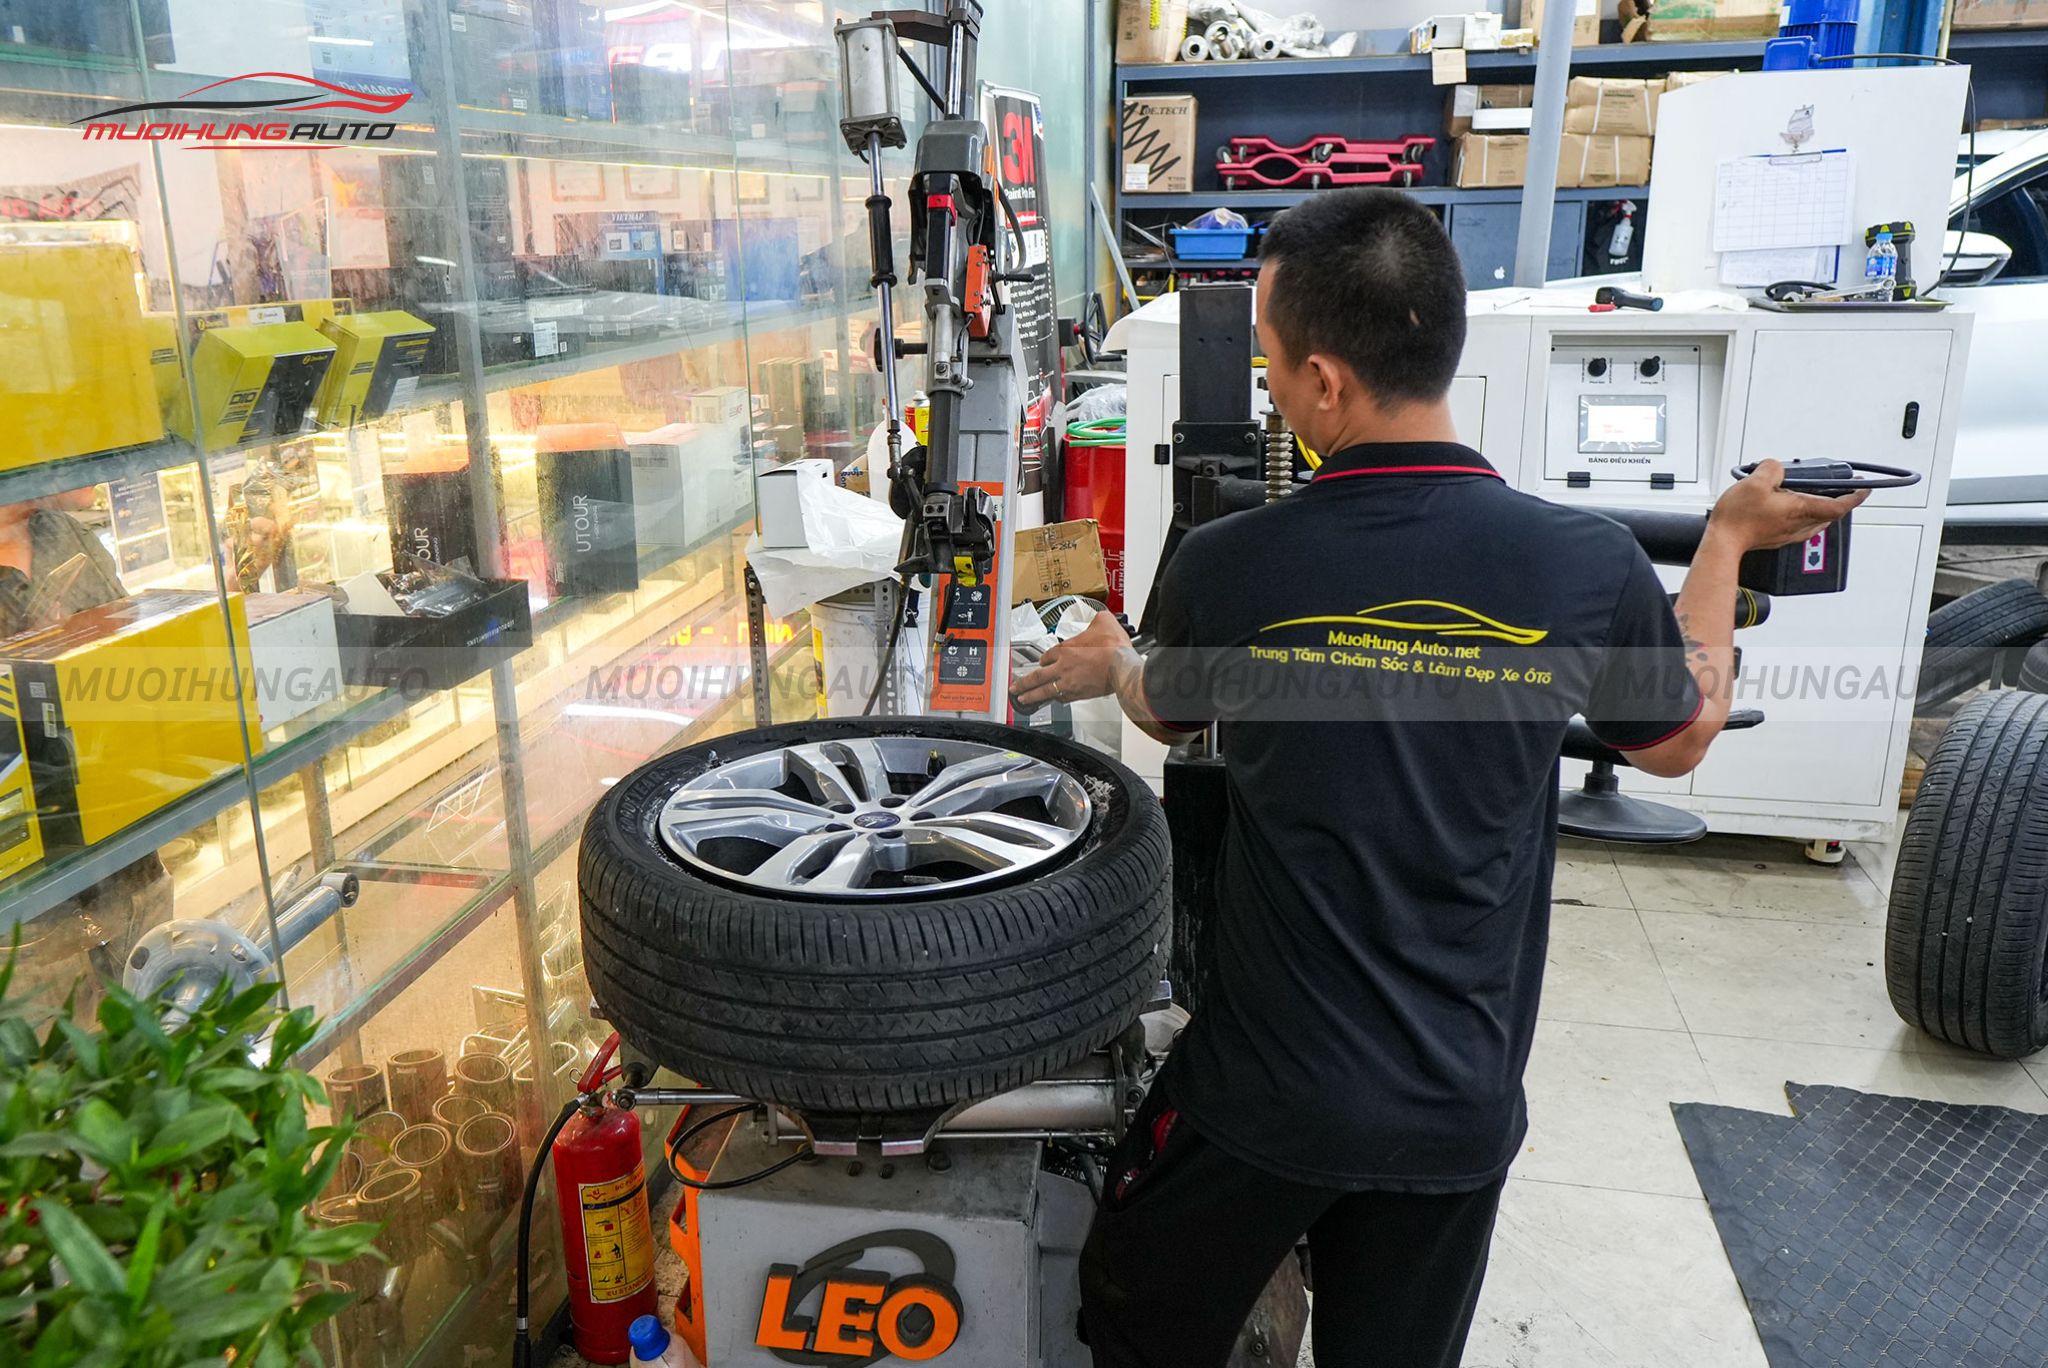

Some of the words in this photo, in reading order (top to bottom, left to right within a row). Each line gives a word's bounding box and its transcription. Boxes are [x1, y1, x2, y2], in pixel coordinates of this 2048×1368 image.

[1003, 112, 1035, 184] 3M
[414, 527, 432, 561] OUR
[572, 494, 592, 552] UTOUR
[1248, 646, 1288, 663] Trung
[1292, 647, 1325, 663] Tâm
[1330, 651, 1377, 669] Chăm
[1380, 656, 1409, 672] Sóc
[1412, 660, 1425, 673] &
[1428, 662, 1461, 677] Làm
[1464, 665, 1496, 683] Đẹp
[1500, 668, 1520, 682] Xe
[755, 1263, 964, 1361] LEO
